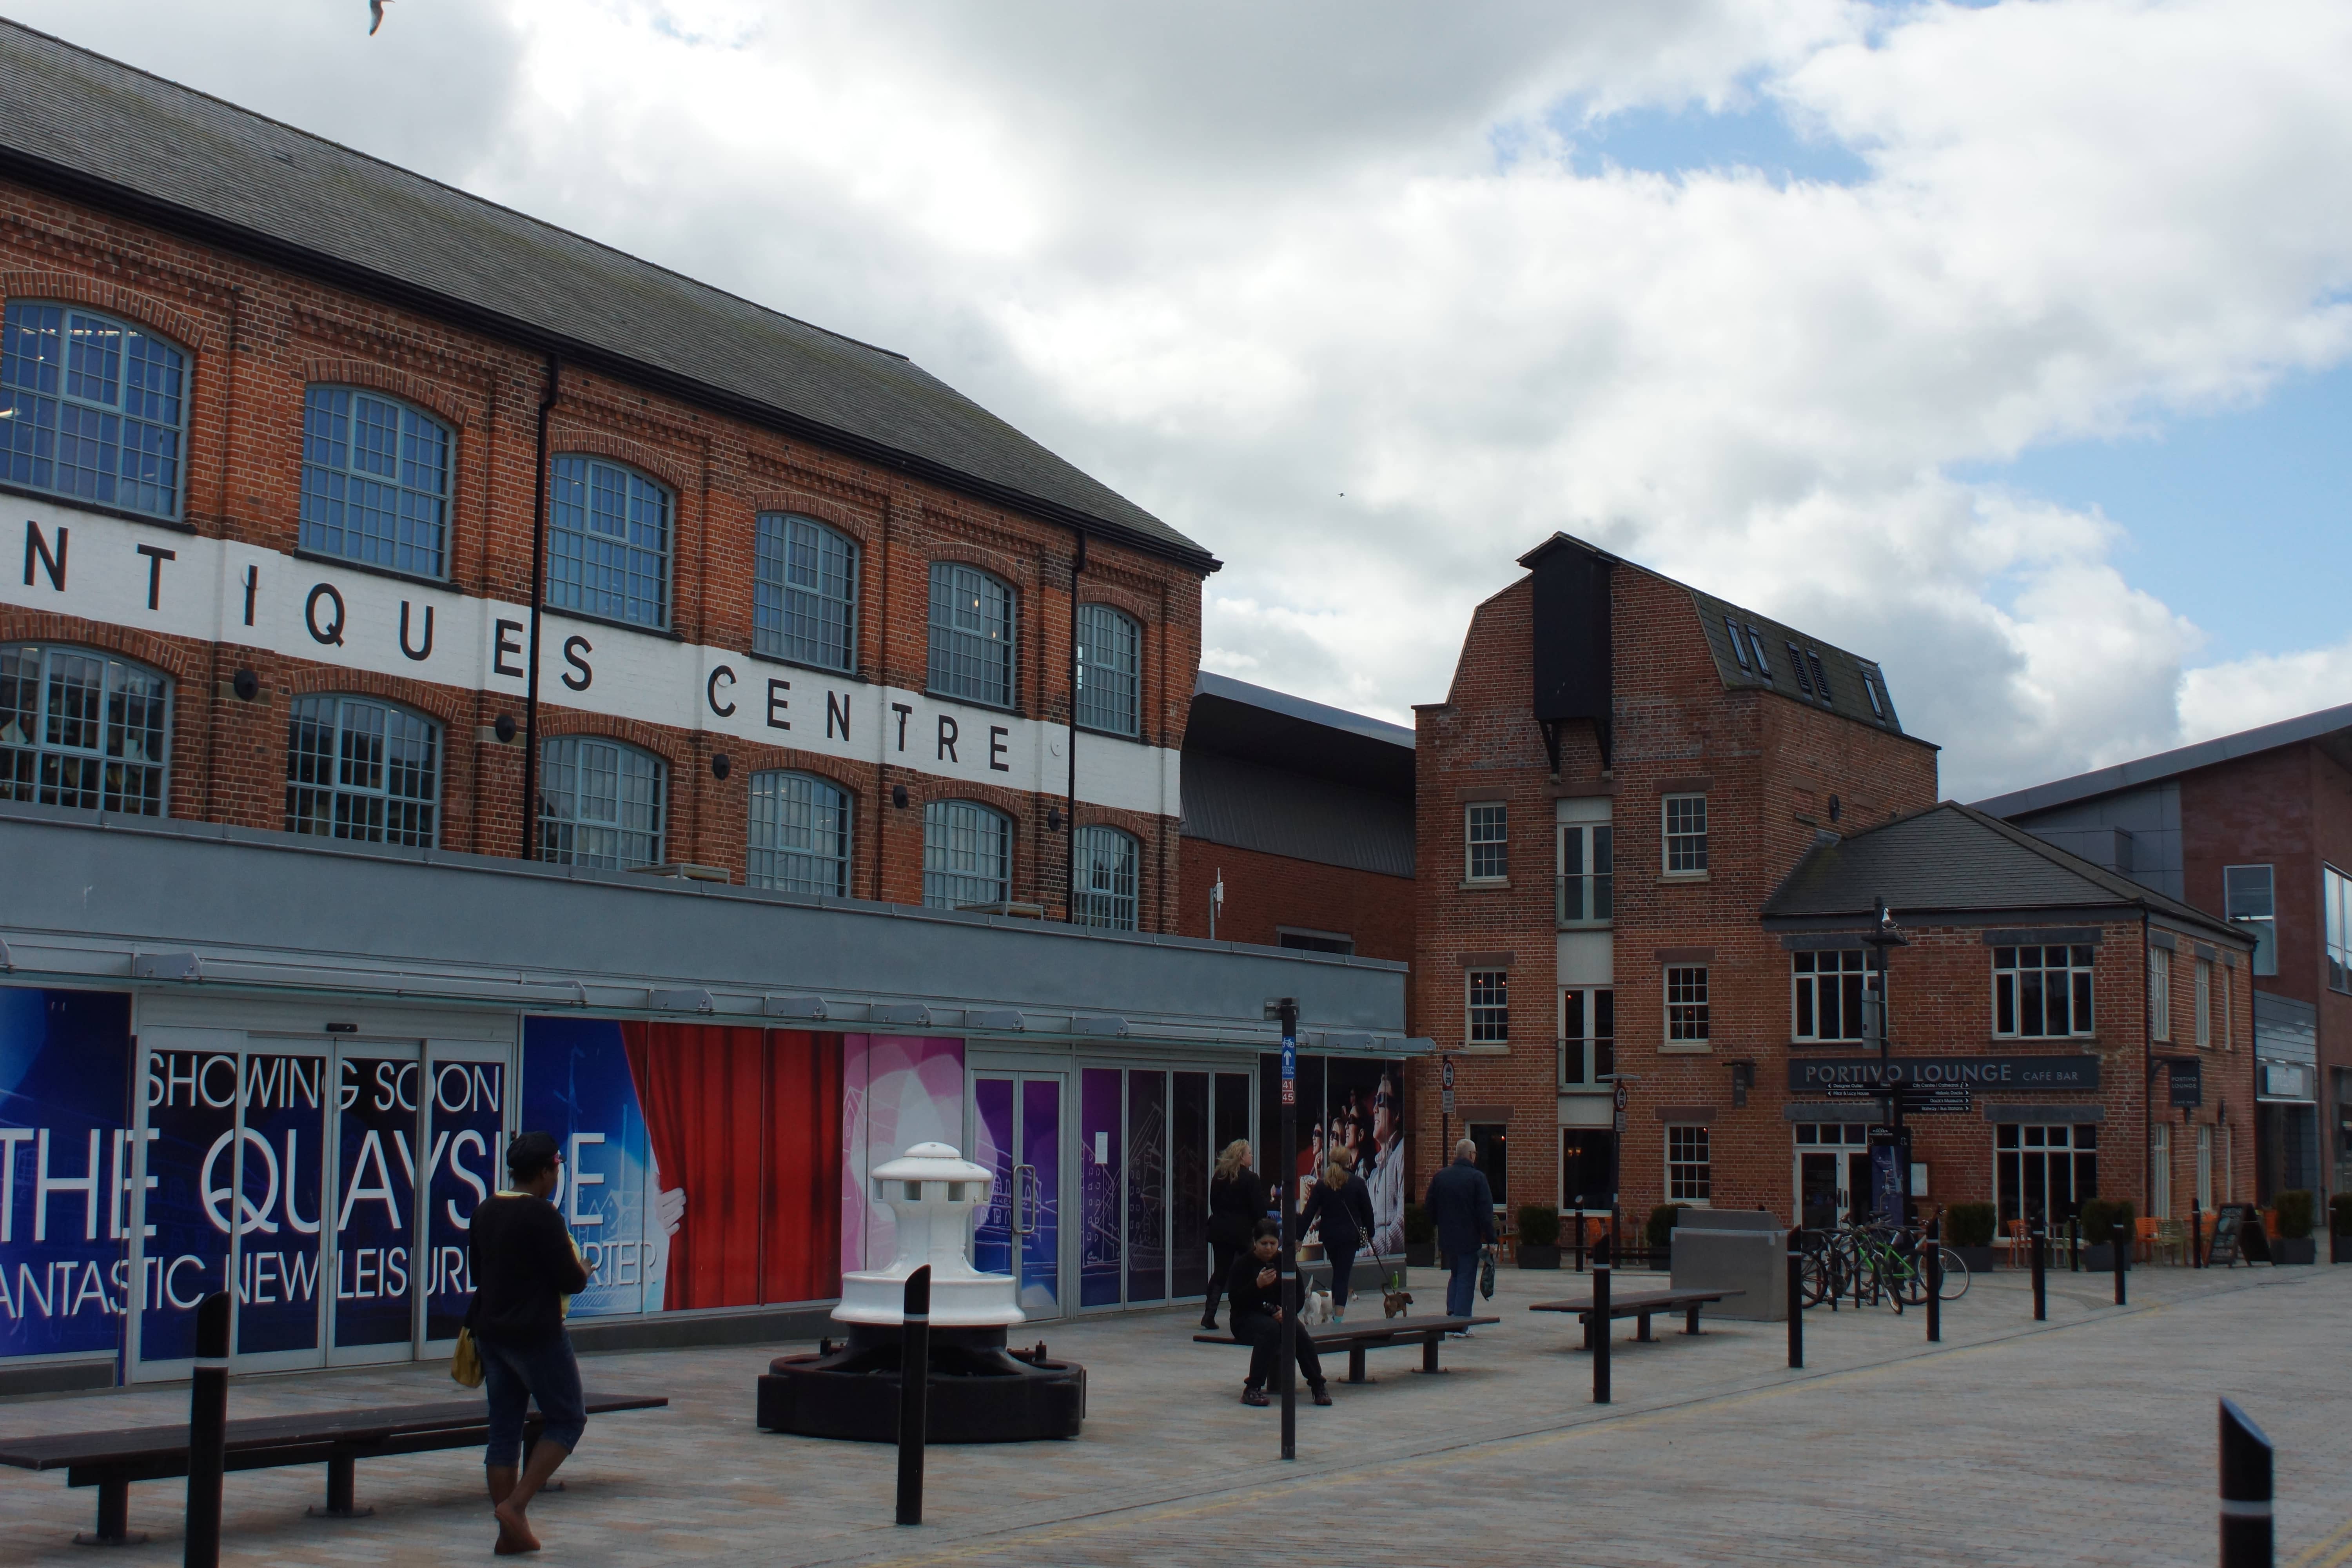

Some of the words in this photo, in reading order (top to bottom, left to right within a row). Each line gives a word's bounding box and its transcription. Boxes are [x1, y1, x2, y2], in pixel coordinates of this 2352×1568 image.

[707, 665, 1009, 772] CENTRE
[149, 1053, 359, 1110] SHOWING
[374, 1061, 499, 1111] SOON
[1282, 1093, 1293, 1101] 45
[1805, 1065, 1902, 1082] PORTIVO
[1913, 1064, 2011, 1082] LOUNGE
[2056, 1071, 2078, 1080] BAR
[0, 1128, 160, 1242] THE
[224, 1250, 319, 1303] NEW
[582, 1240, 657, 1286] RTER
